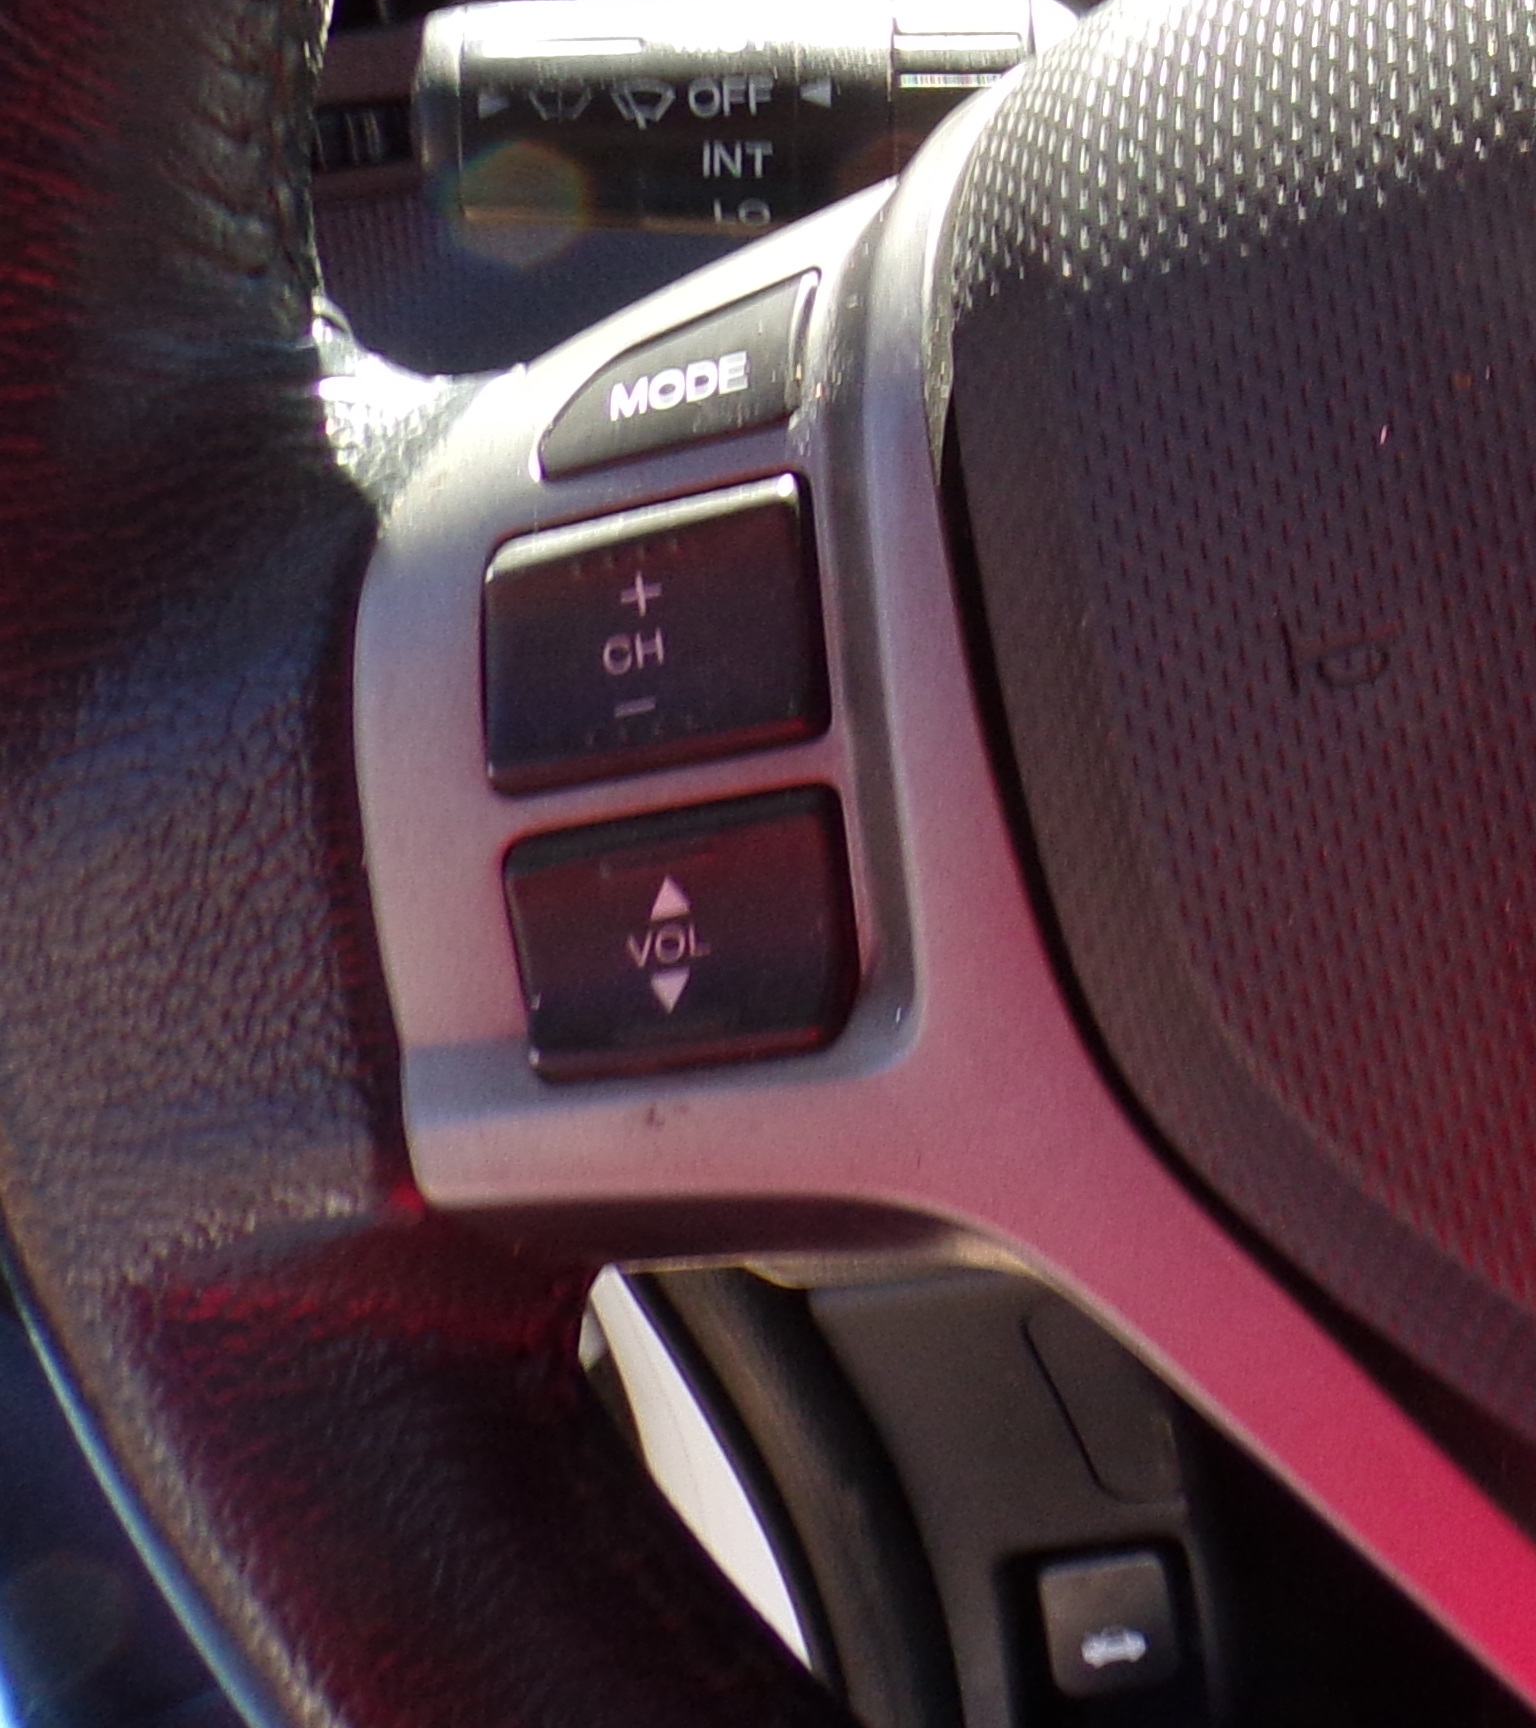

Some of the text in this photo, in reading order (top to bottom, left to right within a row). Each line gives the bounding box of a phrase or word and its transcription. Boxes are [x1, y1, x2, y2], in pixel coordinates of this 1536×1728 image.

[687, 74, 774, 119] OFF
[701, 139, 774, 180] INT
[712, 197, 772, 227] LO
[608, 349, 748, 422] MODE
[602, 627, 665, 676] CH
[625, 921, 713, 969] VOL
